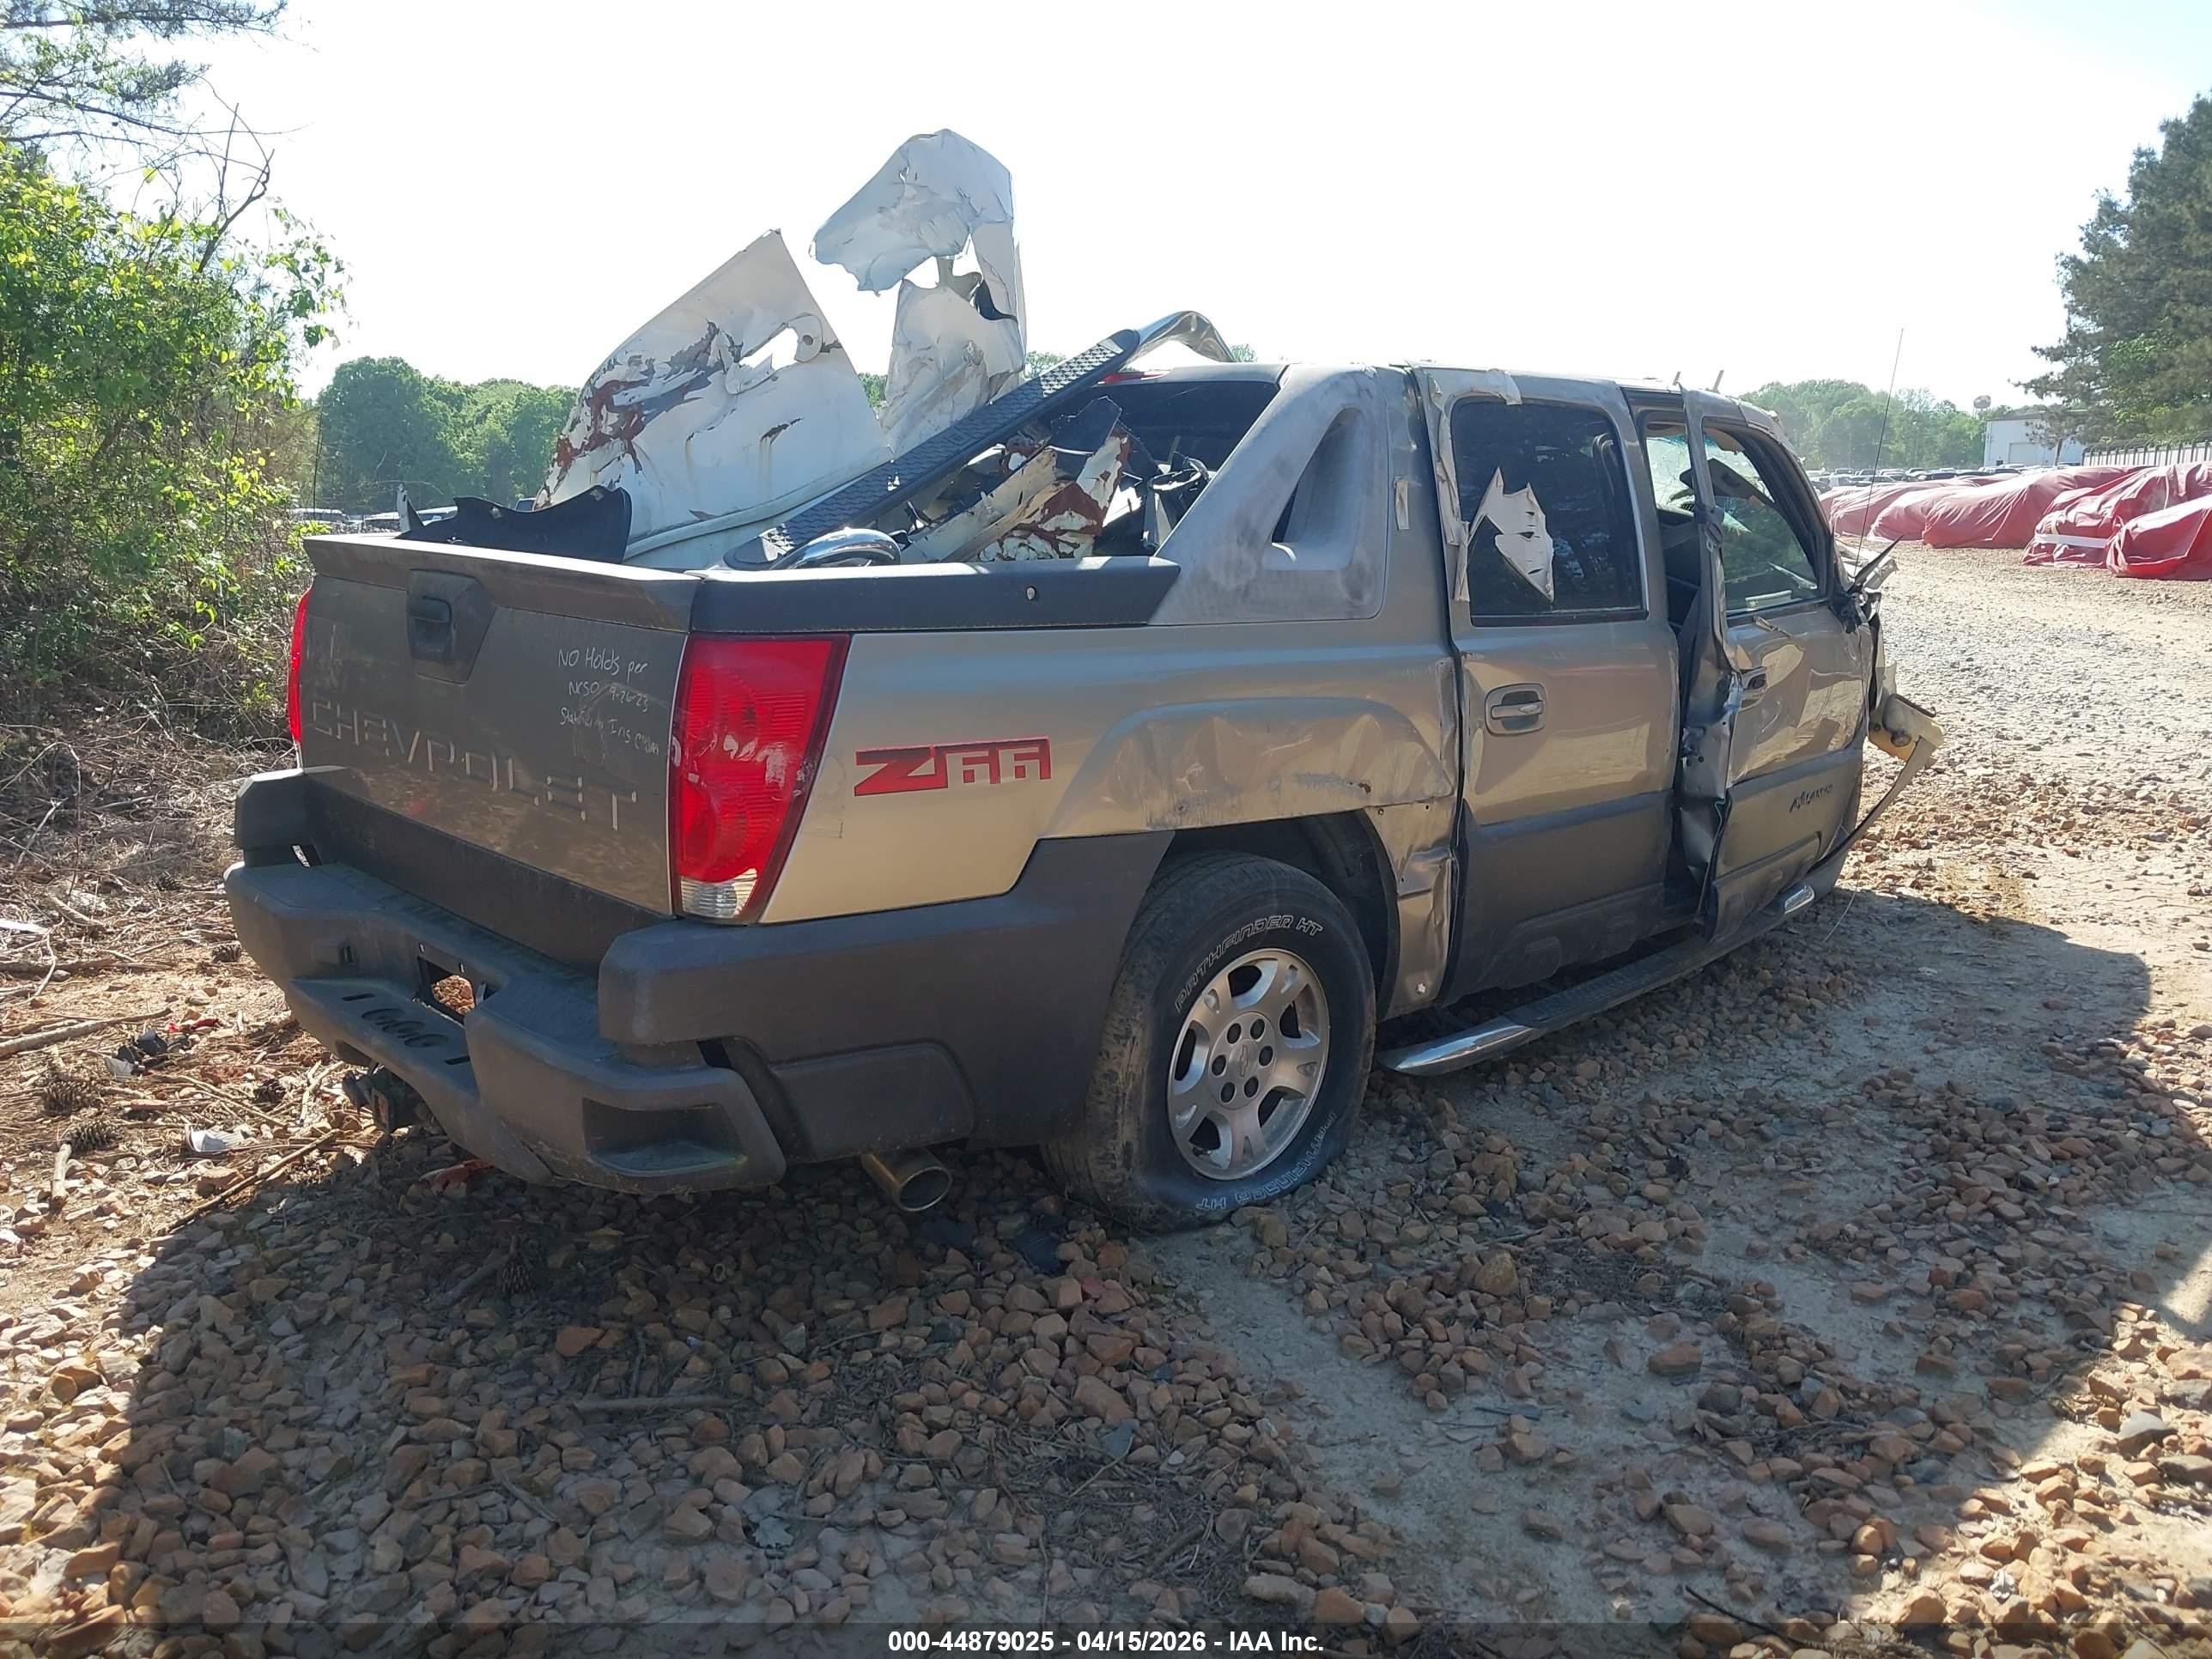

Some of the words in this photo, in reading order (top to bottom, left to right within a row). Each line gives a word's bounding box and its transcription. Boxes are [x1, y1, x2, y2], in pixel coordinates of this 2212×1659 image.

[585, 647, 620, 676] Holds
[627, 661, 648, 684] per
[1174, 915, 1294, 1013] PATHFINDER
[1296, 917, 1323, 937] HT
